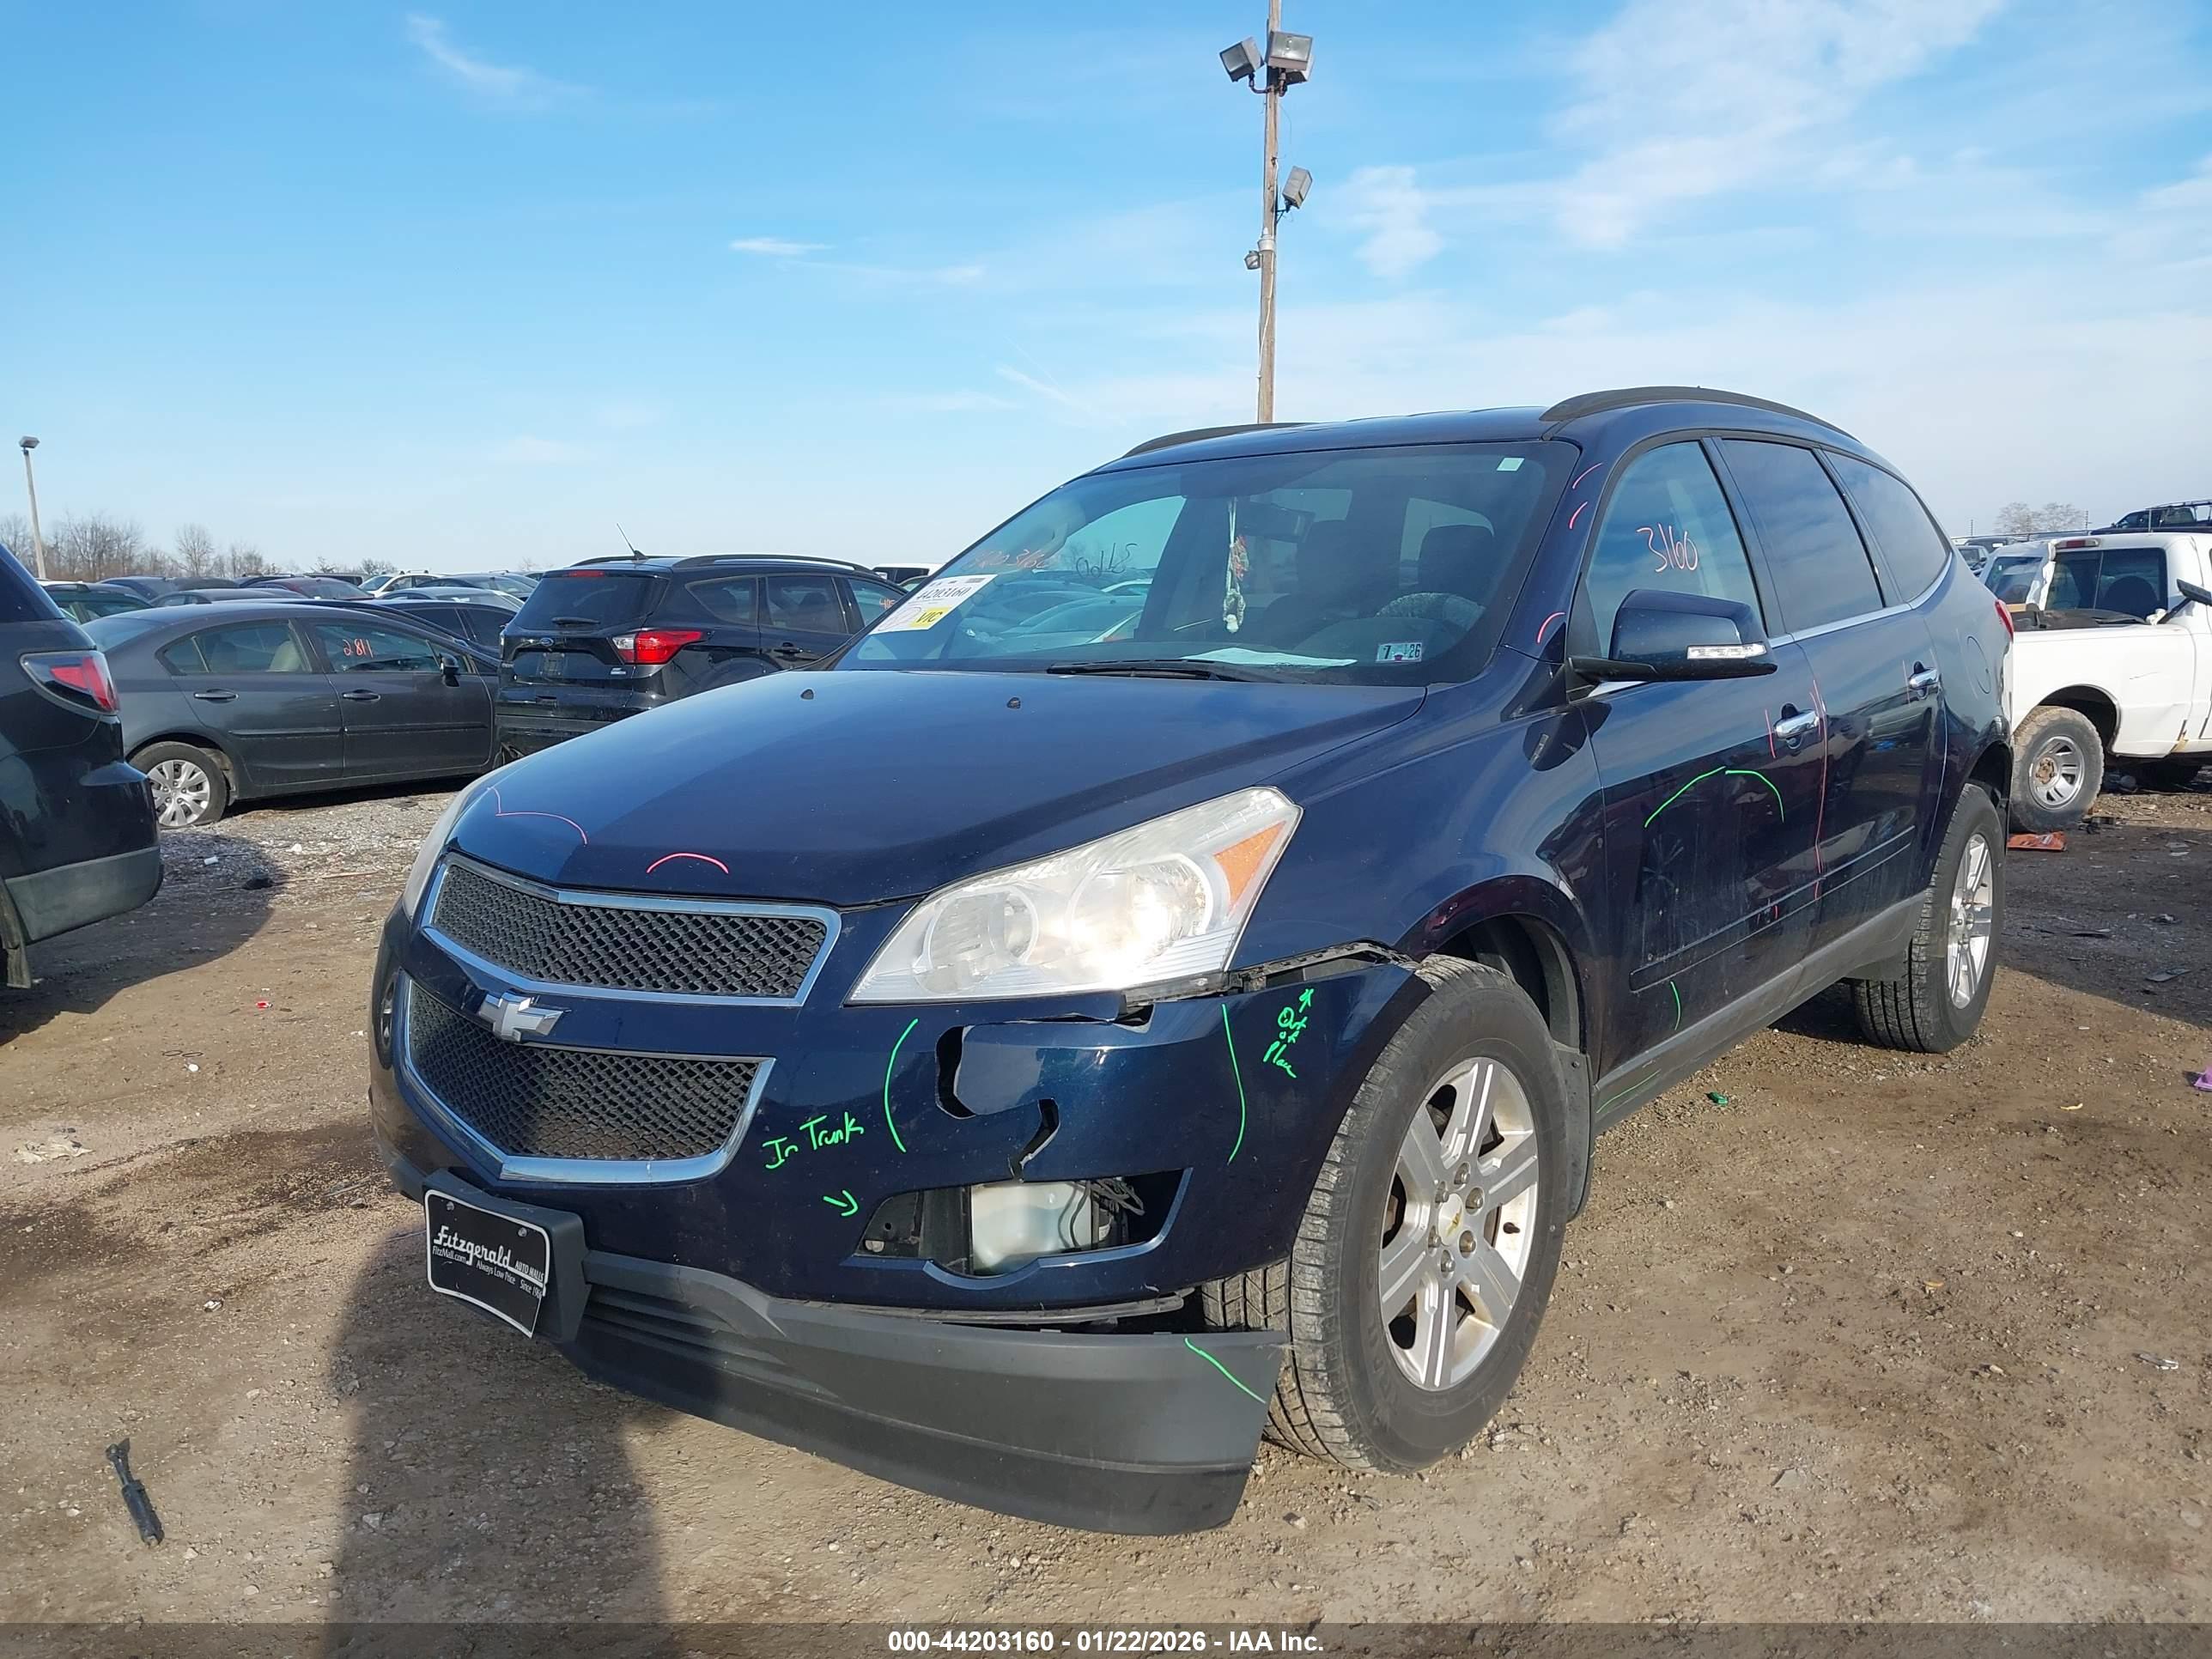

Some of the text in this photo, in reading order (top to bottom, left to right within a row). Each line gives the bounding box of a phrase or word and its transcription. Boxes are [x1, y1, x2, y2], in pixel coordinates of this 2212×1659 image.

[1636, 522, 1699, 573] 3160
[916, 586, 972, 600] 44203160
[916, 611, 944, 623] VIC
[1382, 643, 1421, 659] 7 26
[762, 1111, 865, 1170] In Trunk
[432, 1245, 466, 1264] FitzMall.com
[476, 1260, 494, 1276] Always
[494, 1267, 505, 1280] Low
[520, 1279, 532, 1295] Since
[433, 1224, 512, 1269] Fitzgerald
[514, 1260, 529, 1275] AUTO
